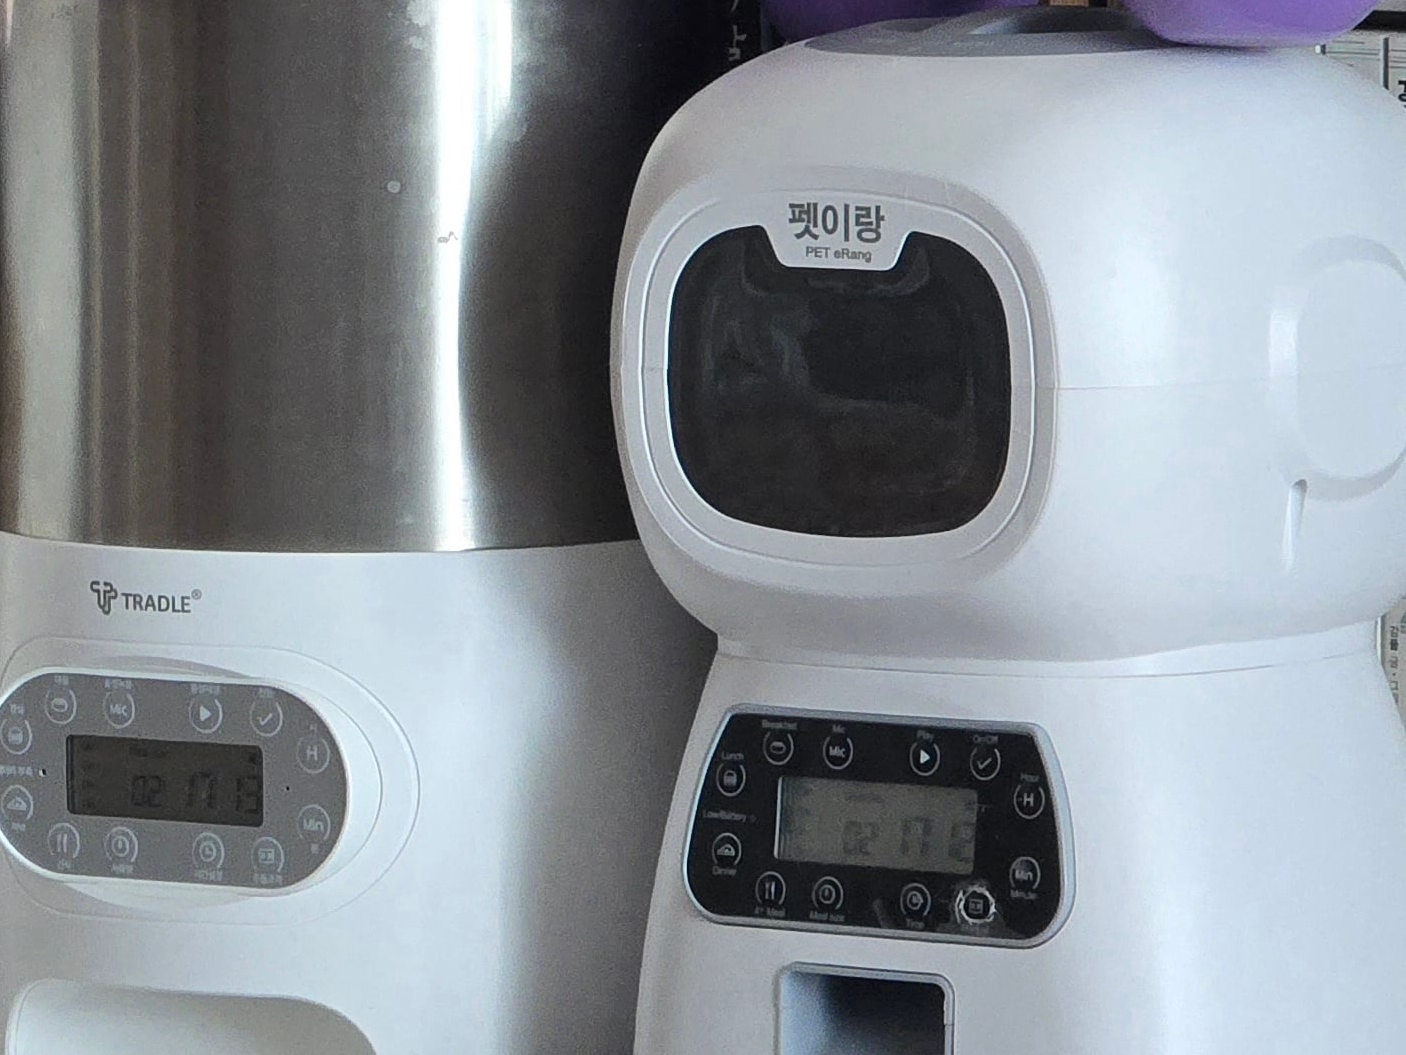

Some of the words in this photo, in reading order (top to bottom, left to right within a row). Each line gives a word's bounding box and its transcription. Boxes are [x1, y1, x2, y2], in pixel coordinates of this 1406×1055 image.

[788, 202, 885, 244] 펫이랑
[805, 246, 830, 259] PET
[834, 248, 872, 263] eRang
[121, 592, 191, 614] TRADLE
[917, 730, 934, 742] Play
[307, 747, 319, 760] H
[721, 751, 745, 761] Lunch
[1020, 772, 1039, 783] Hour
[1022, 792, 1034, 806] H
[1014, 869, 1033, 881] Min
